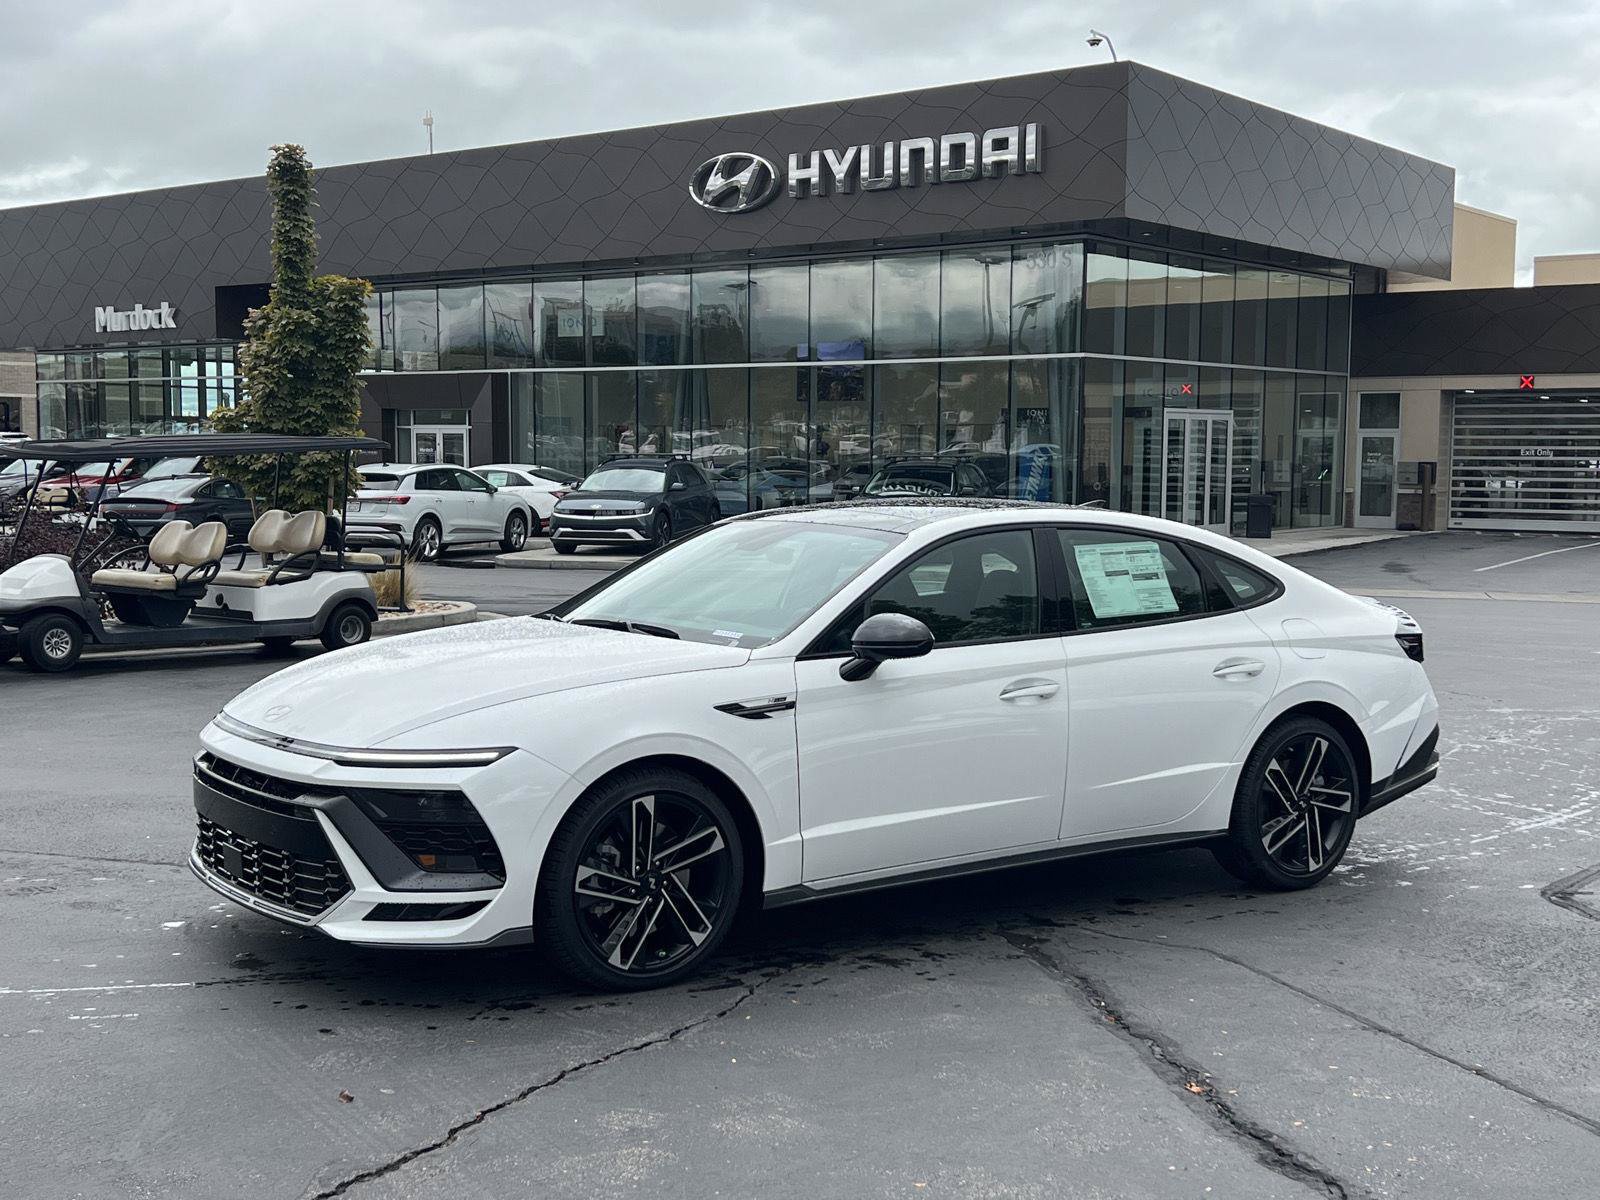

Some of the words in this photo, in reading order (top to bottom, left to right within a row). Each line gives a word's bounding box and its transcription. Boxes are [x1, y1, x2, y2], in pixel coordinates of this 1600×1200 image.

[788, 122, 1042, 198] HYUNDAI
[95, 302, 176, 332] Murdock
[1536, 448, 1554, 460] Only
